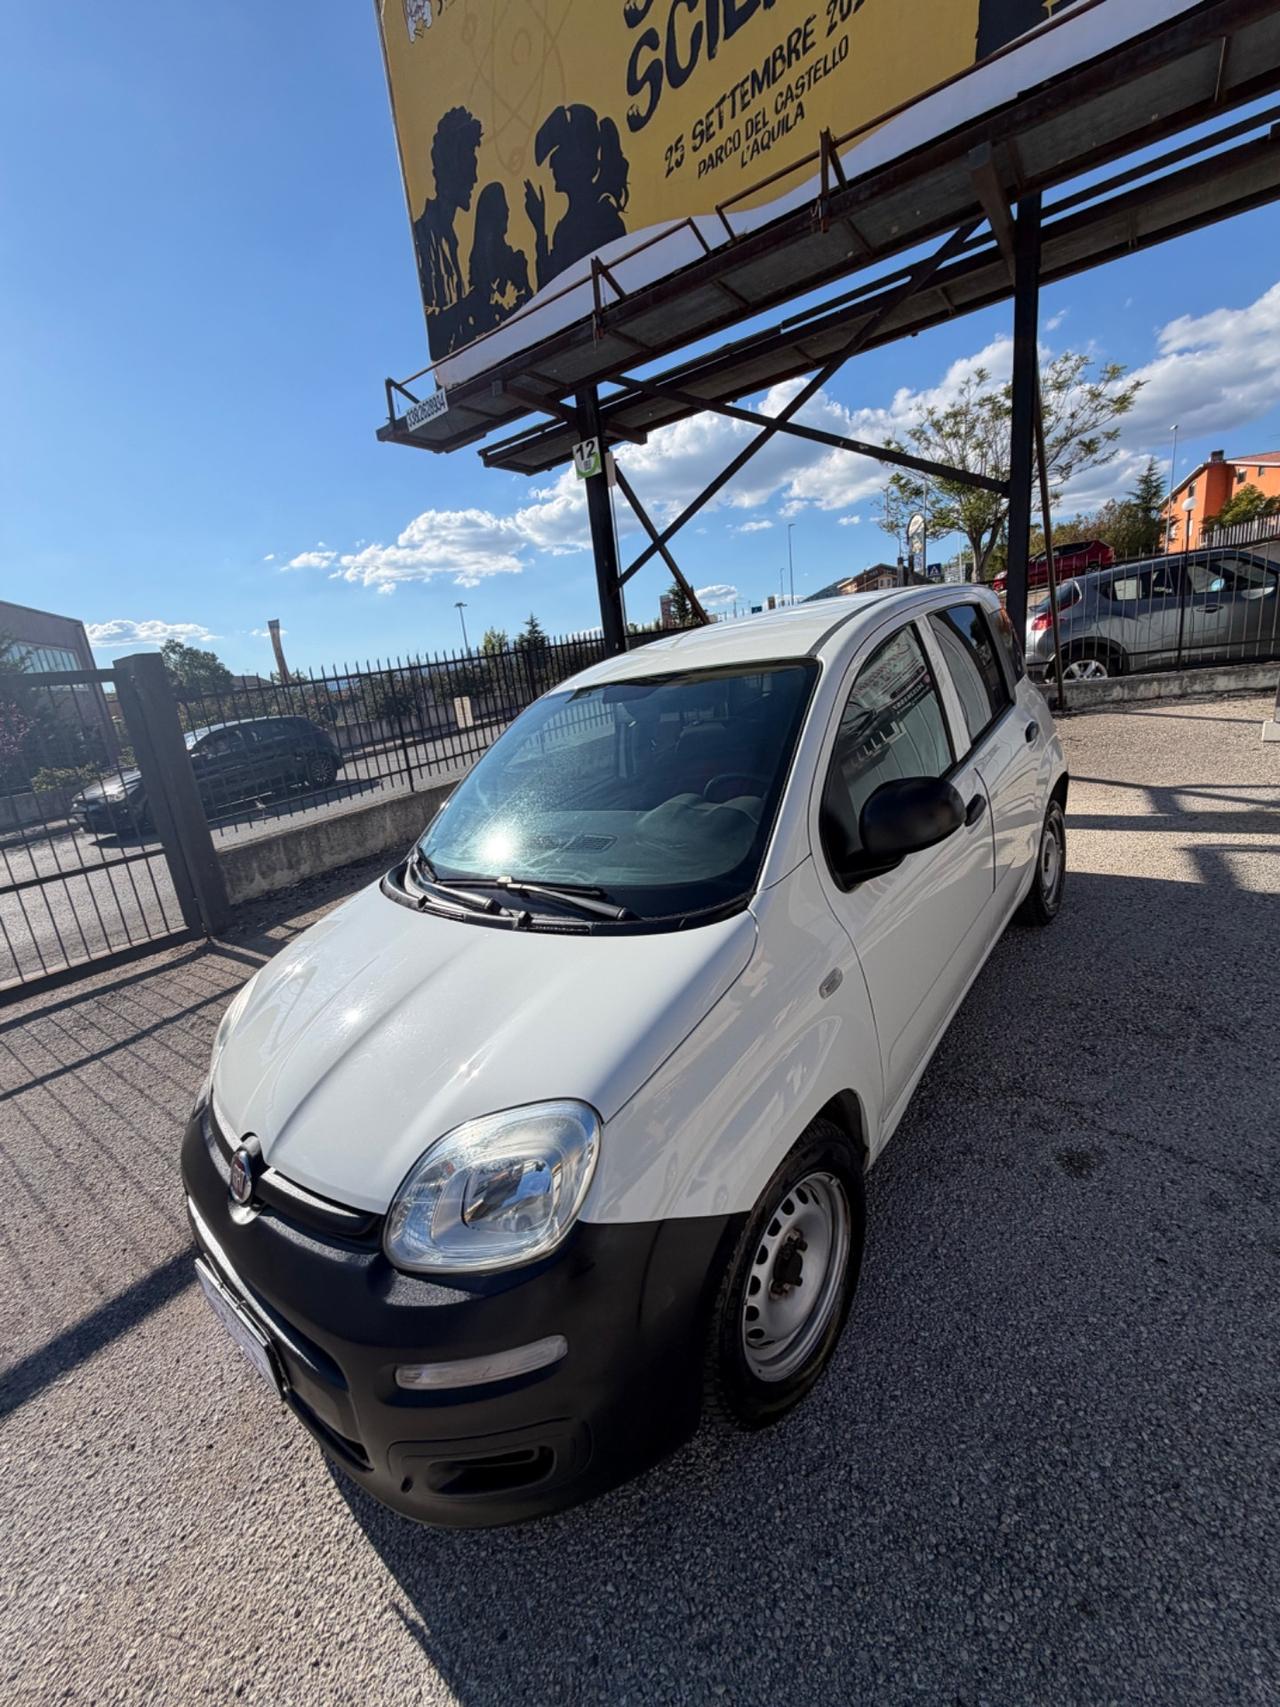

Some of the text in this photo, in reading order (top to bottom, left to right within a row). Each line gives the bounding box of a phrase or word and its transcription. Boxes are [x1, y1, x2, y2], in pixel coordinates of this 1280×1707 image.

[665, 134, 685, 178] 25
[691, 14, 817, 152] SETTEMBRE
[698, 34, 849, 179] PARCO DEL CASTELLO
[740, 101, 805, 169] L'AQUILA
[576, 440, 597, 461] 12
